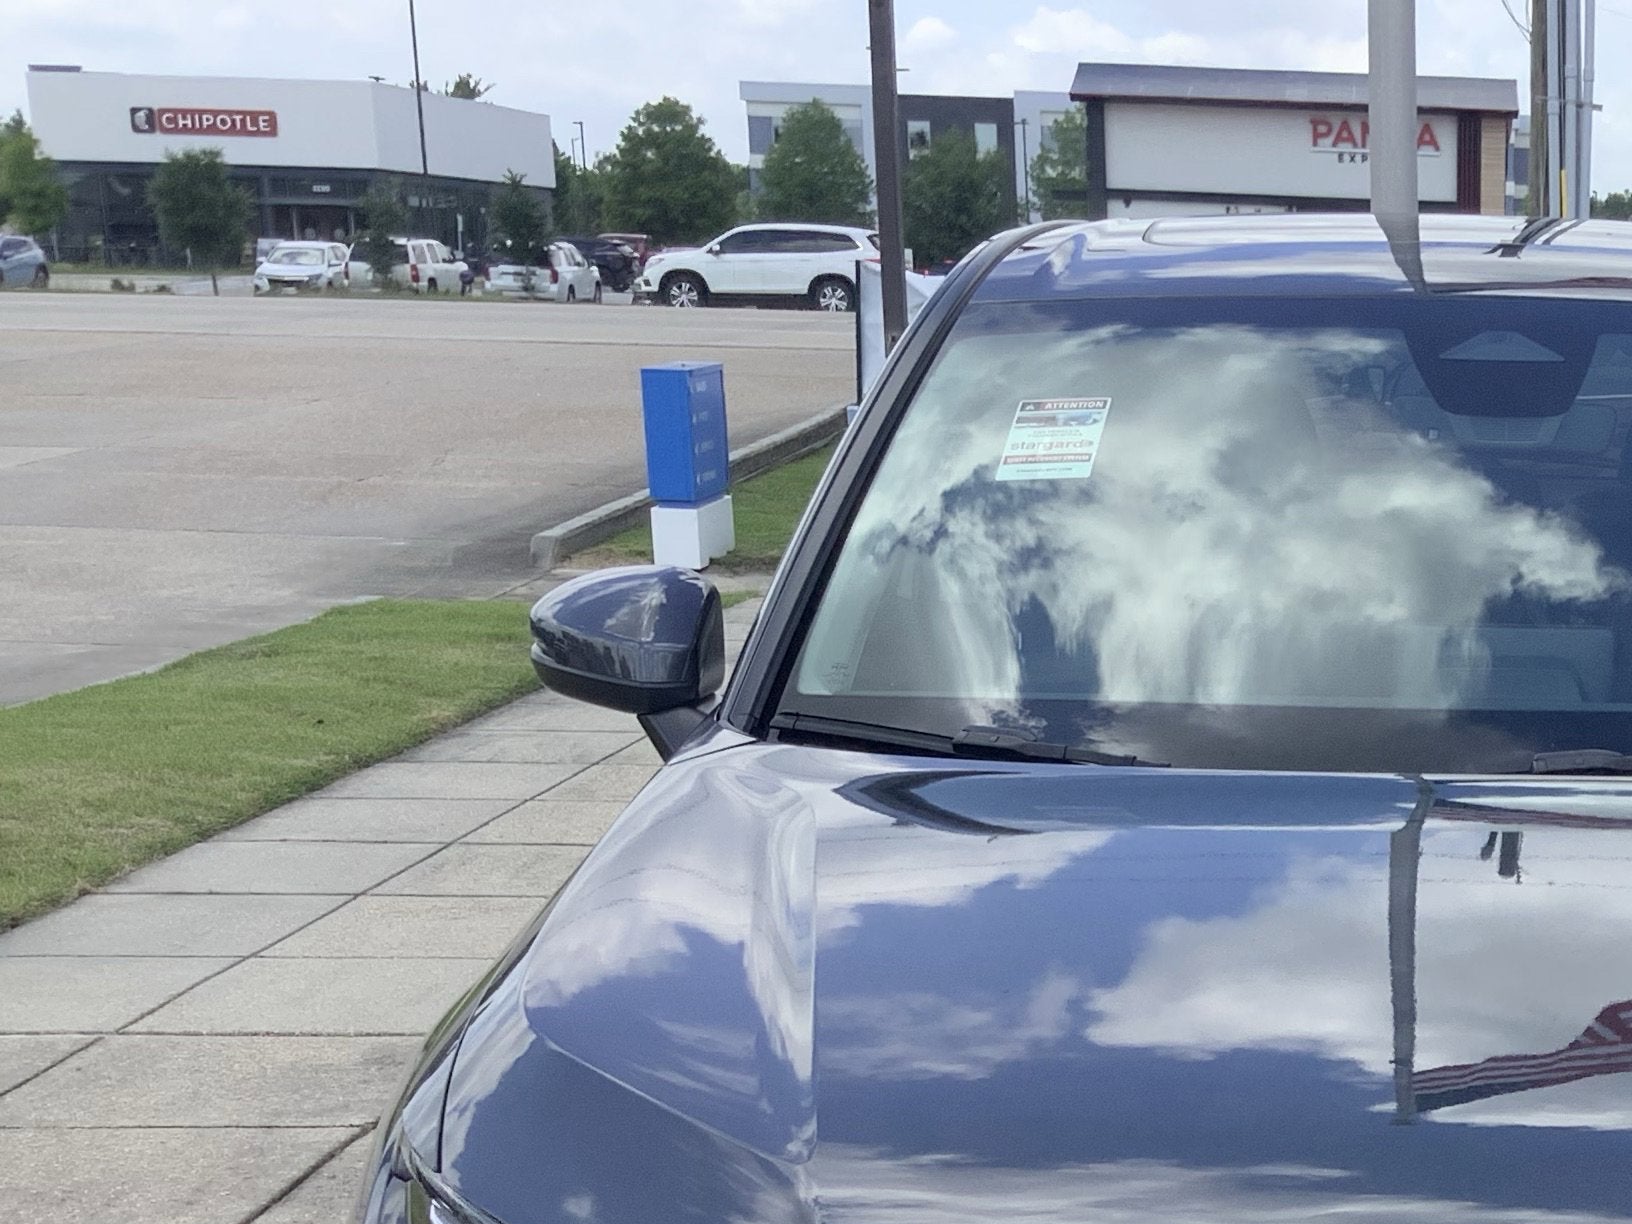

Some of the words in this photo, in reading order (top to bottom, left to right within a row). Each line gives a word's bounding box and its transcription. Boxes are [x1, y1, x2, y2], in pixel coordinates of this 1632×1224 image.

[161, 112, 271, 131] CHIPOTLE
[1310, 118, 1440, 150] PAA
[1043, 400, 1105, 410] ATTENTION
